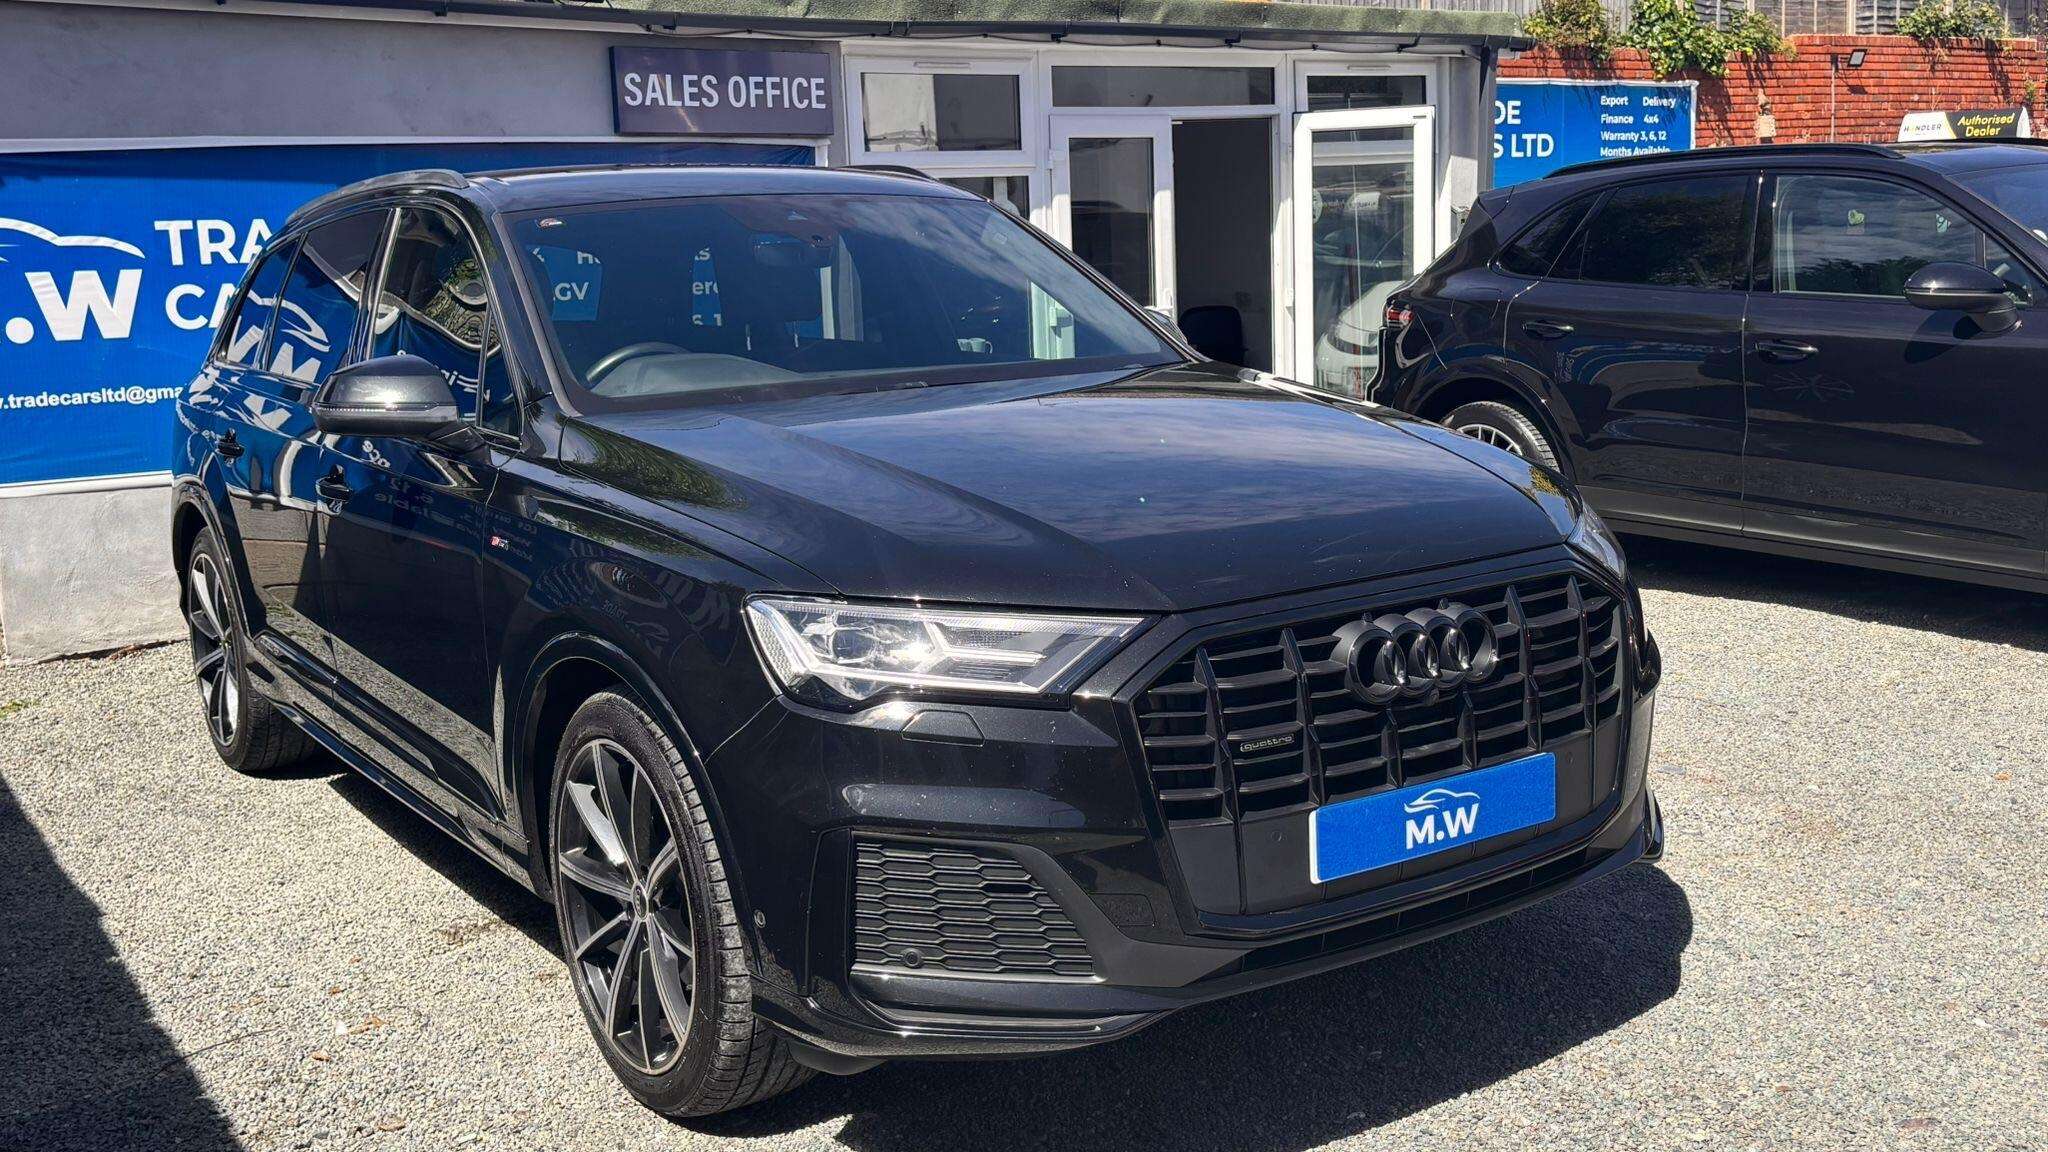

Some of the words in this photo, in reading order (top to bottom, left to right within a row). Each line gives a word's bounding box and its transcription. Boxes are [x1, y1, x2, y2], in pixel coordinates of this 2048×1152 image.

[624, 72, 720, 108] SALES
[727, 75, 827, 109] OFFICE
[1600, 95, 1629, 108] Export
[1642, 96, 1677, 109] Delivery
[1600, 113, 1634, 124] Finance
[1643, 114, 1660, 124] 4x4
[1957, 112, 2016, 126] Authorised
[1600, 131, 1640, 143] Warranty
[1658, 130, 1667, 141] 12
[1965, 124, 2001, 137] Dealer
[1511, 133, 1555, 158] LTD
[1600, 146, 1632, 157] Months
[0, 268, 143, 344] .W
[1240, 733, 1295, 752] quattro
[1405, 803, 1479, 850] M.W
